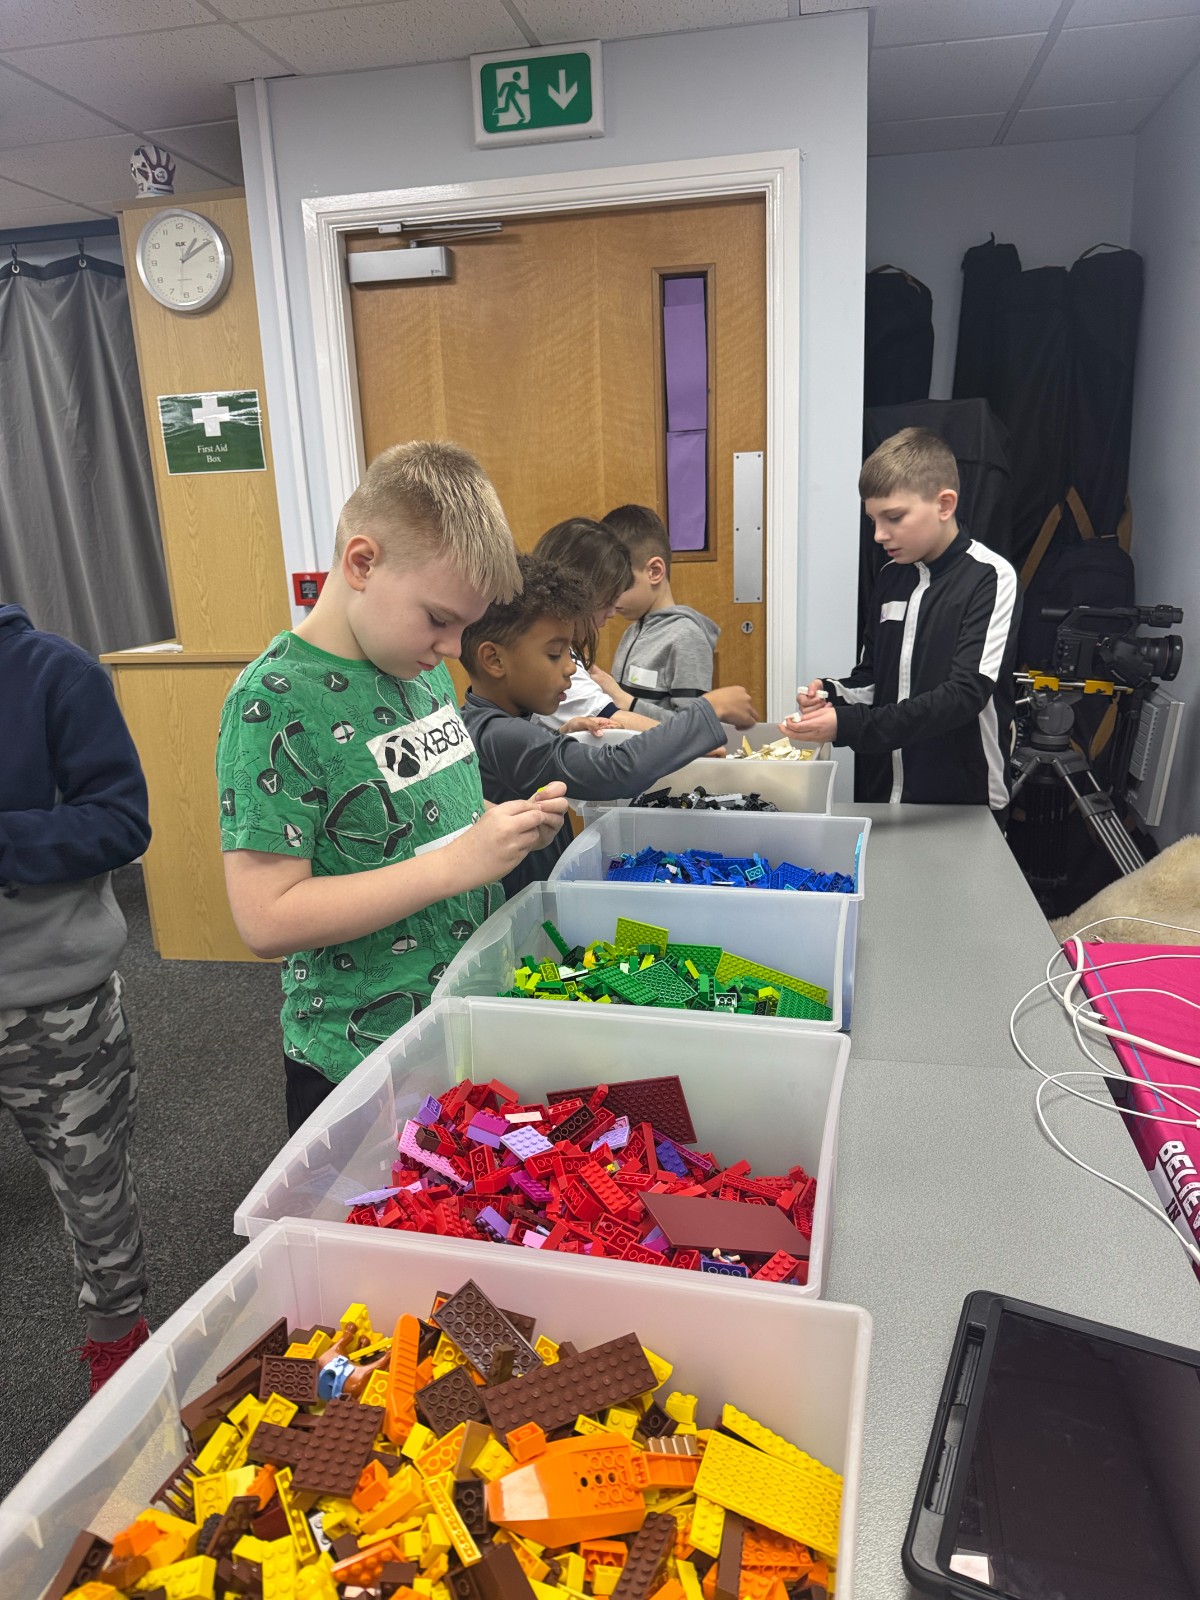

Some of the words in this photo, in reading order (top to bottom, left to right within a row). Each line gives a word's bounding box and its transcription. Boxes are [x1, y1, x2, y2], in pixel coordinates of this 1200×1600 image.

[197, 445, 213, 453] First
[215, 444, 228, 452] Aid
[206, 455, 222, 463] Box
[414, 717, 468, 761] XBOX
